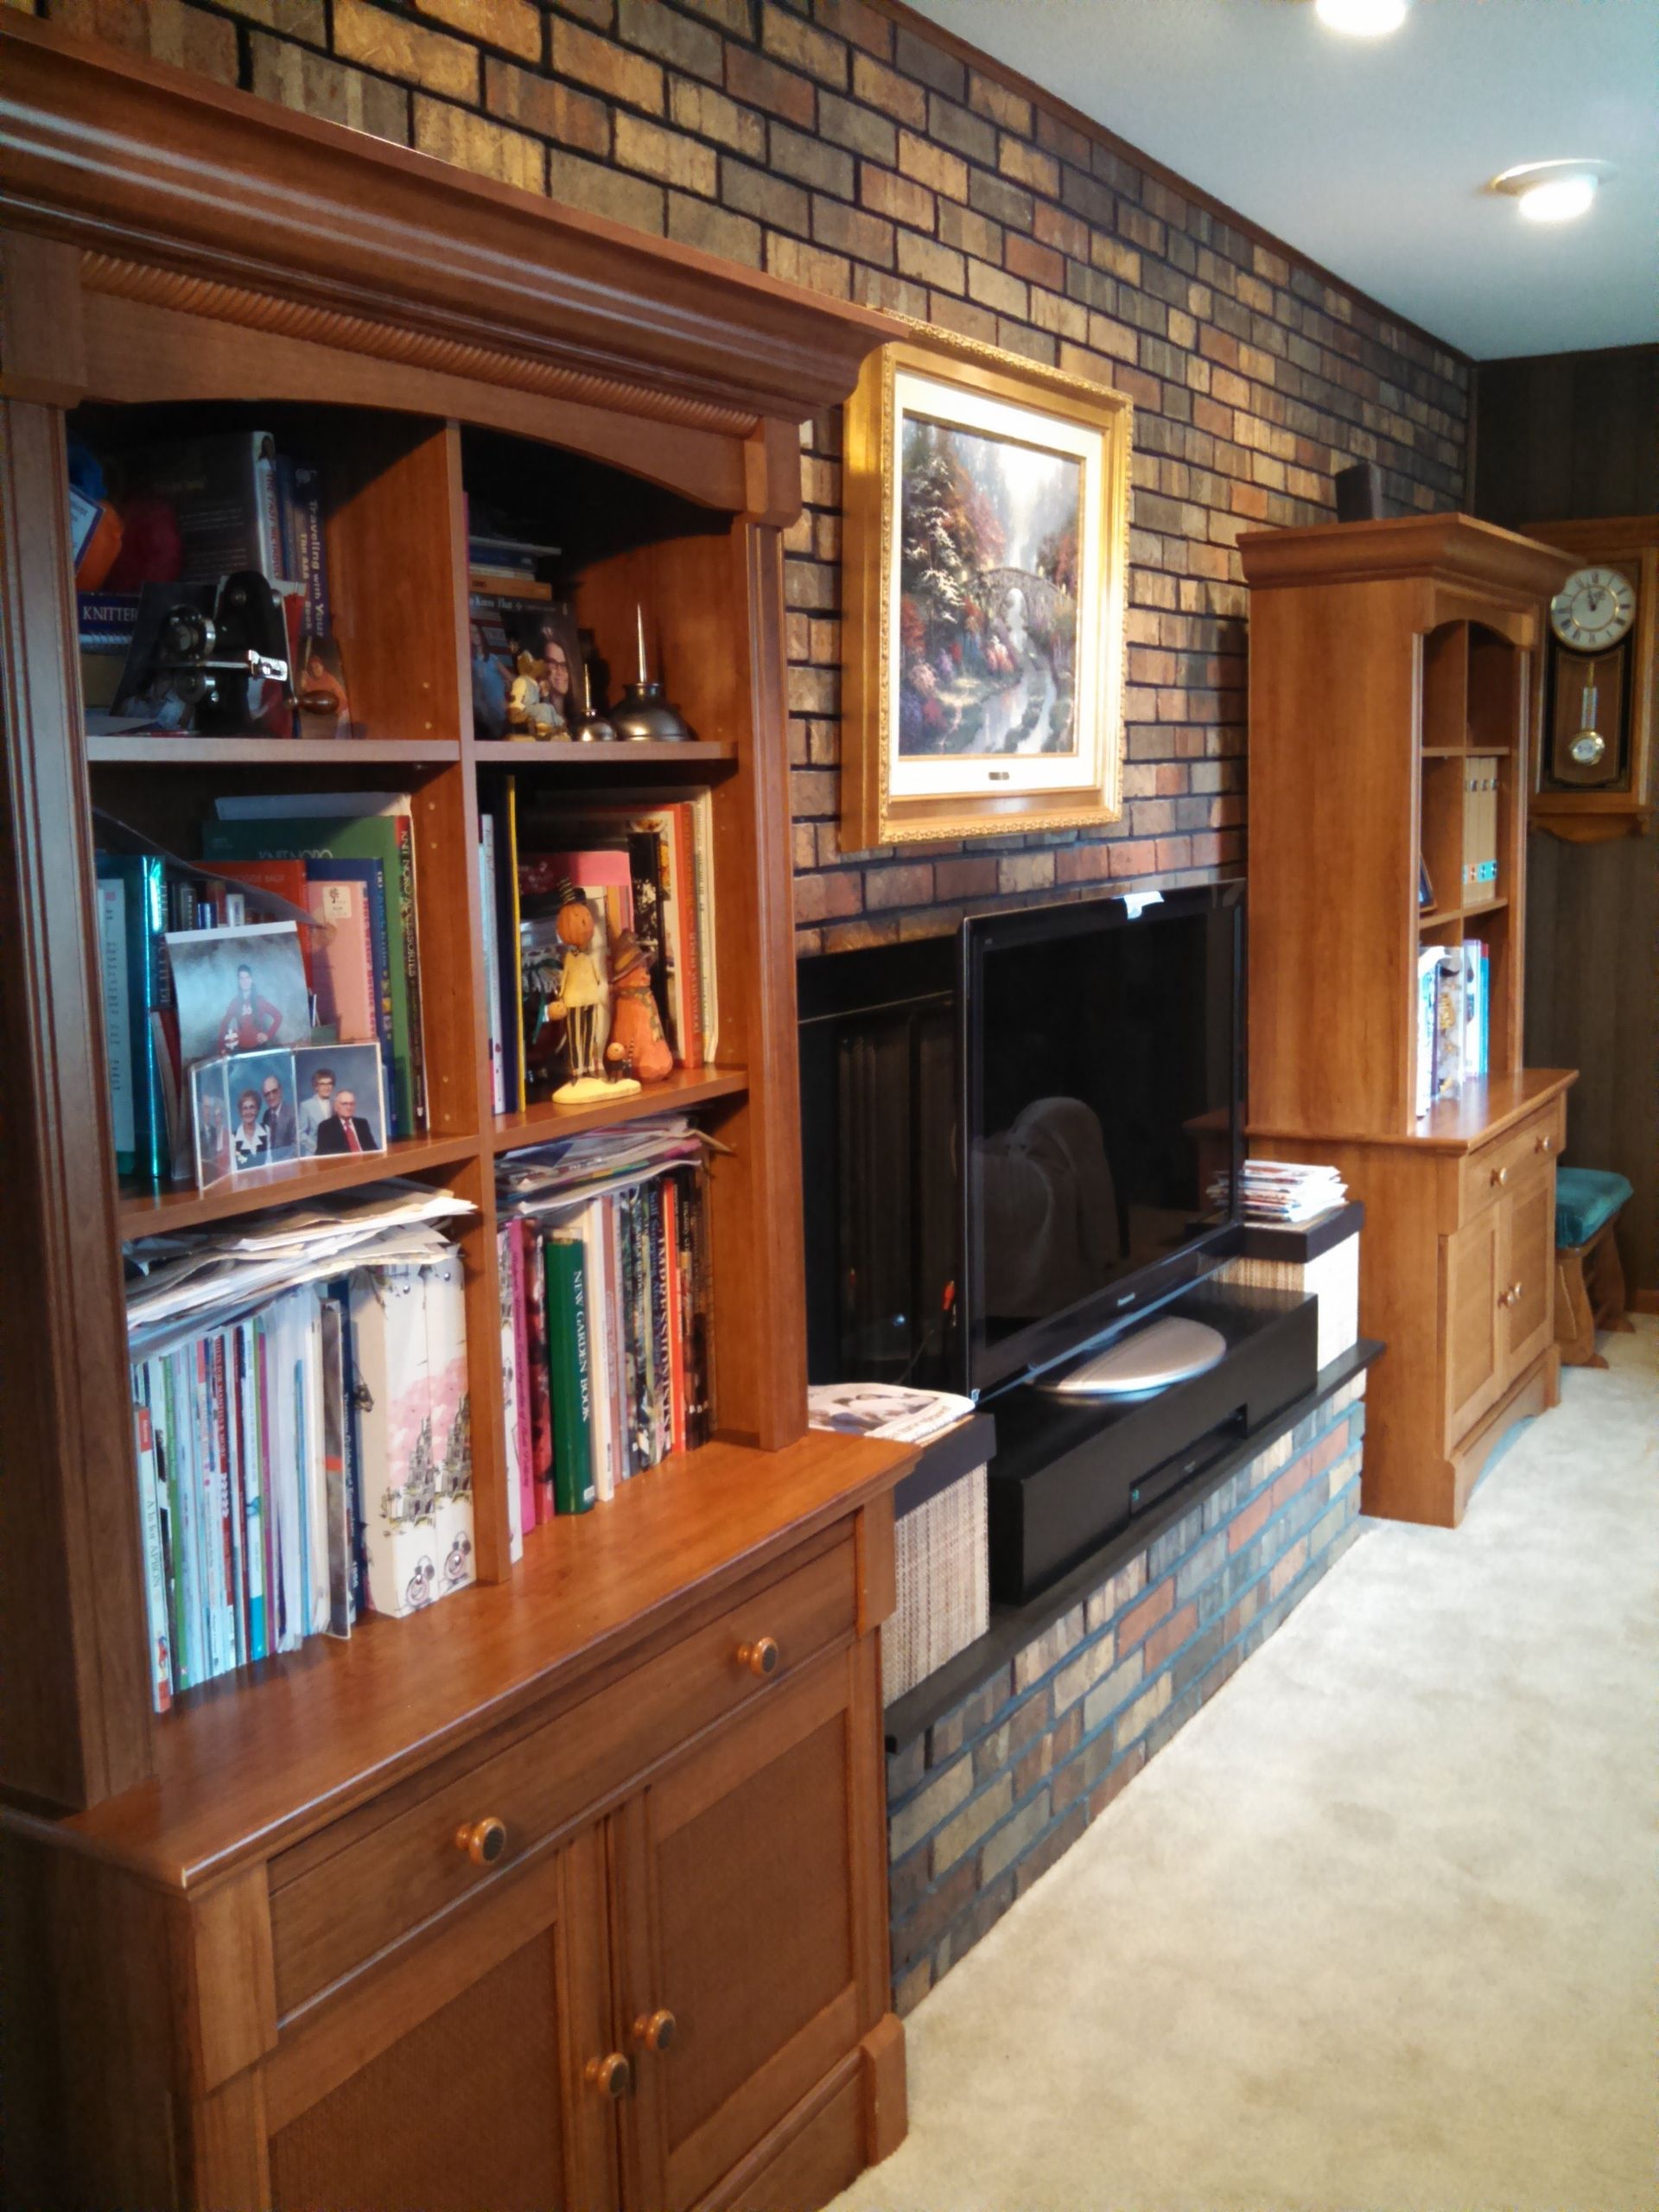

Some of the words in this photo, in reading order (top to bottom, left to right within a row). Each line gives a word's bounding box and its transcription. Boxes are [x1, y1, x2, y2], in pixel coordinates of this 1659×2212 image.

[309, 499, 321, 570] Traveling
[313, 572, 322, 600] with
[314, 602, 325, 638] Your
[399, 830, 410, 855] KNIT
[402, 860, 411, 893] NORO
[403, 896, 416, 976] ACCESSORIES
[573, 1271, 585, 1306] NEW
[576, 1311, 588, 1372] GARDEN
[657, 1236, 670, 1427] IMPRESSIONISTS
[580, 1378, 590, 1423] BOOK
[145, 1500, 154, 1509] A
[148, 1523, 157, 1539] for
[149, 1544, 162, 1587] APRON
